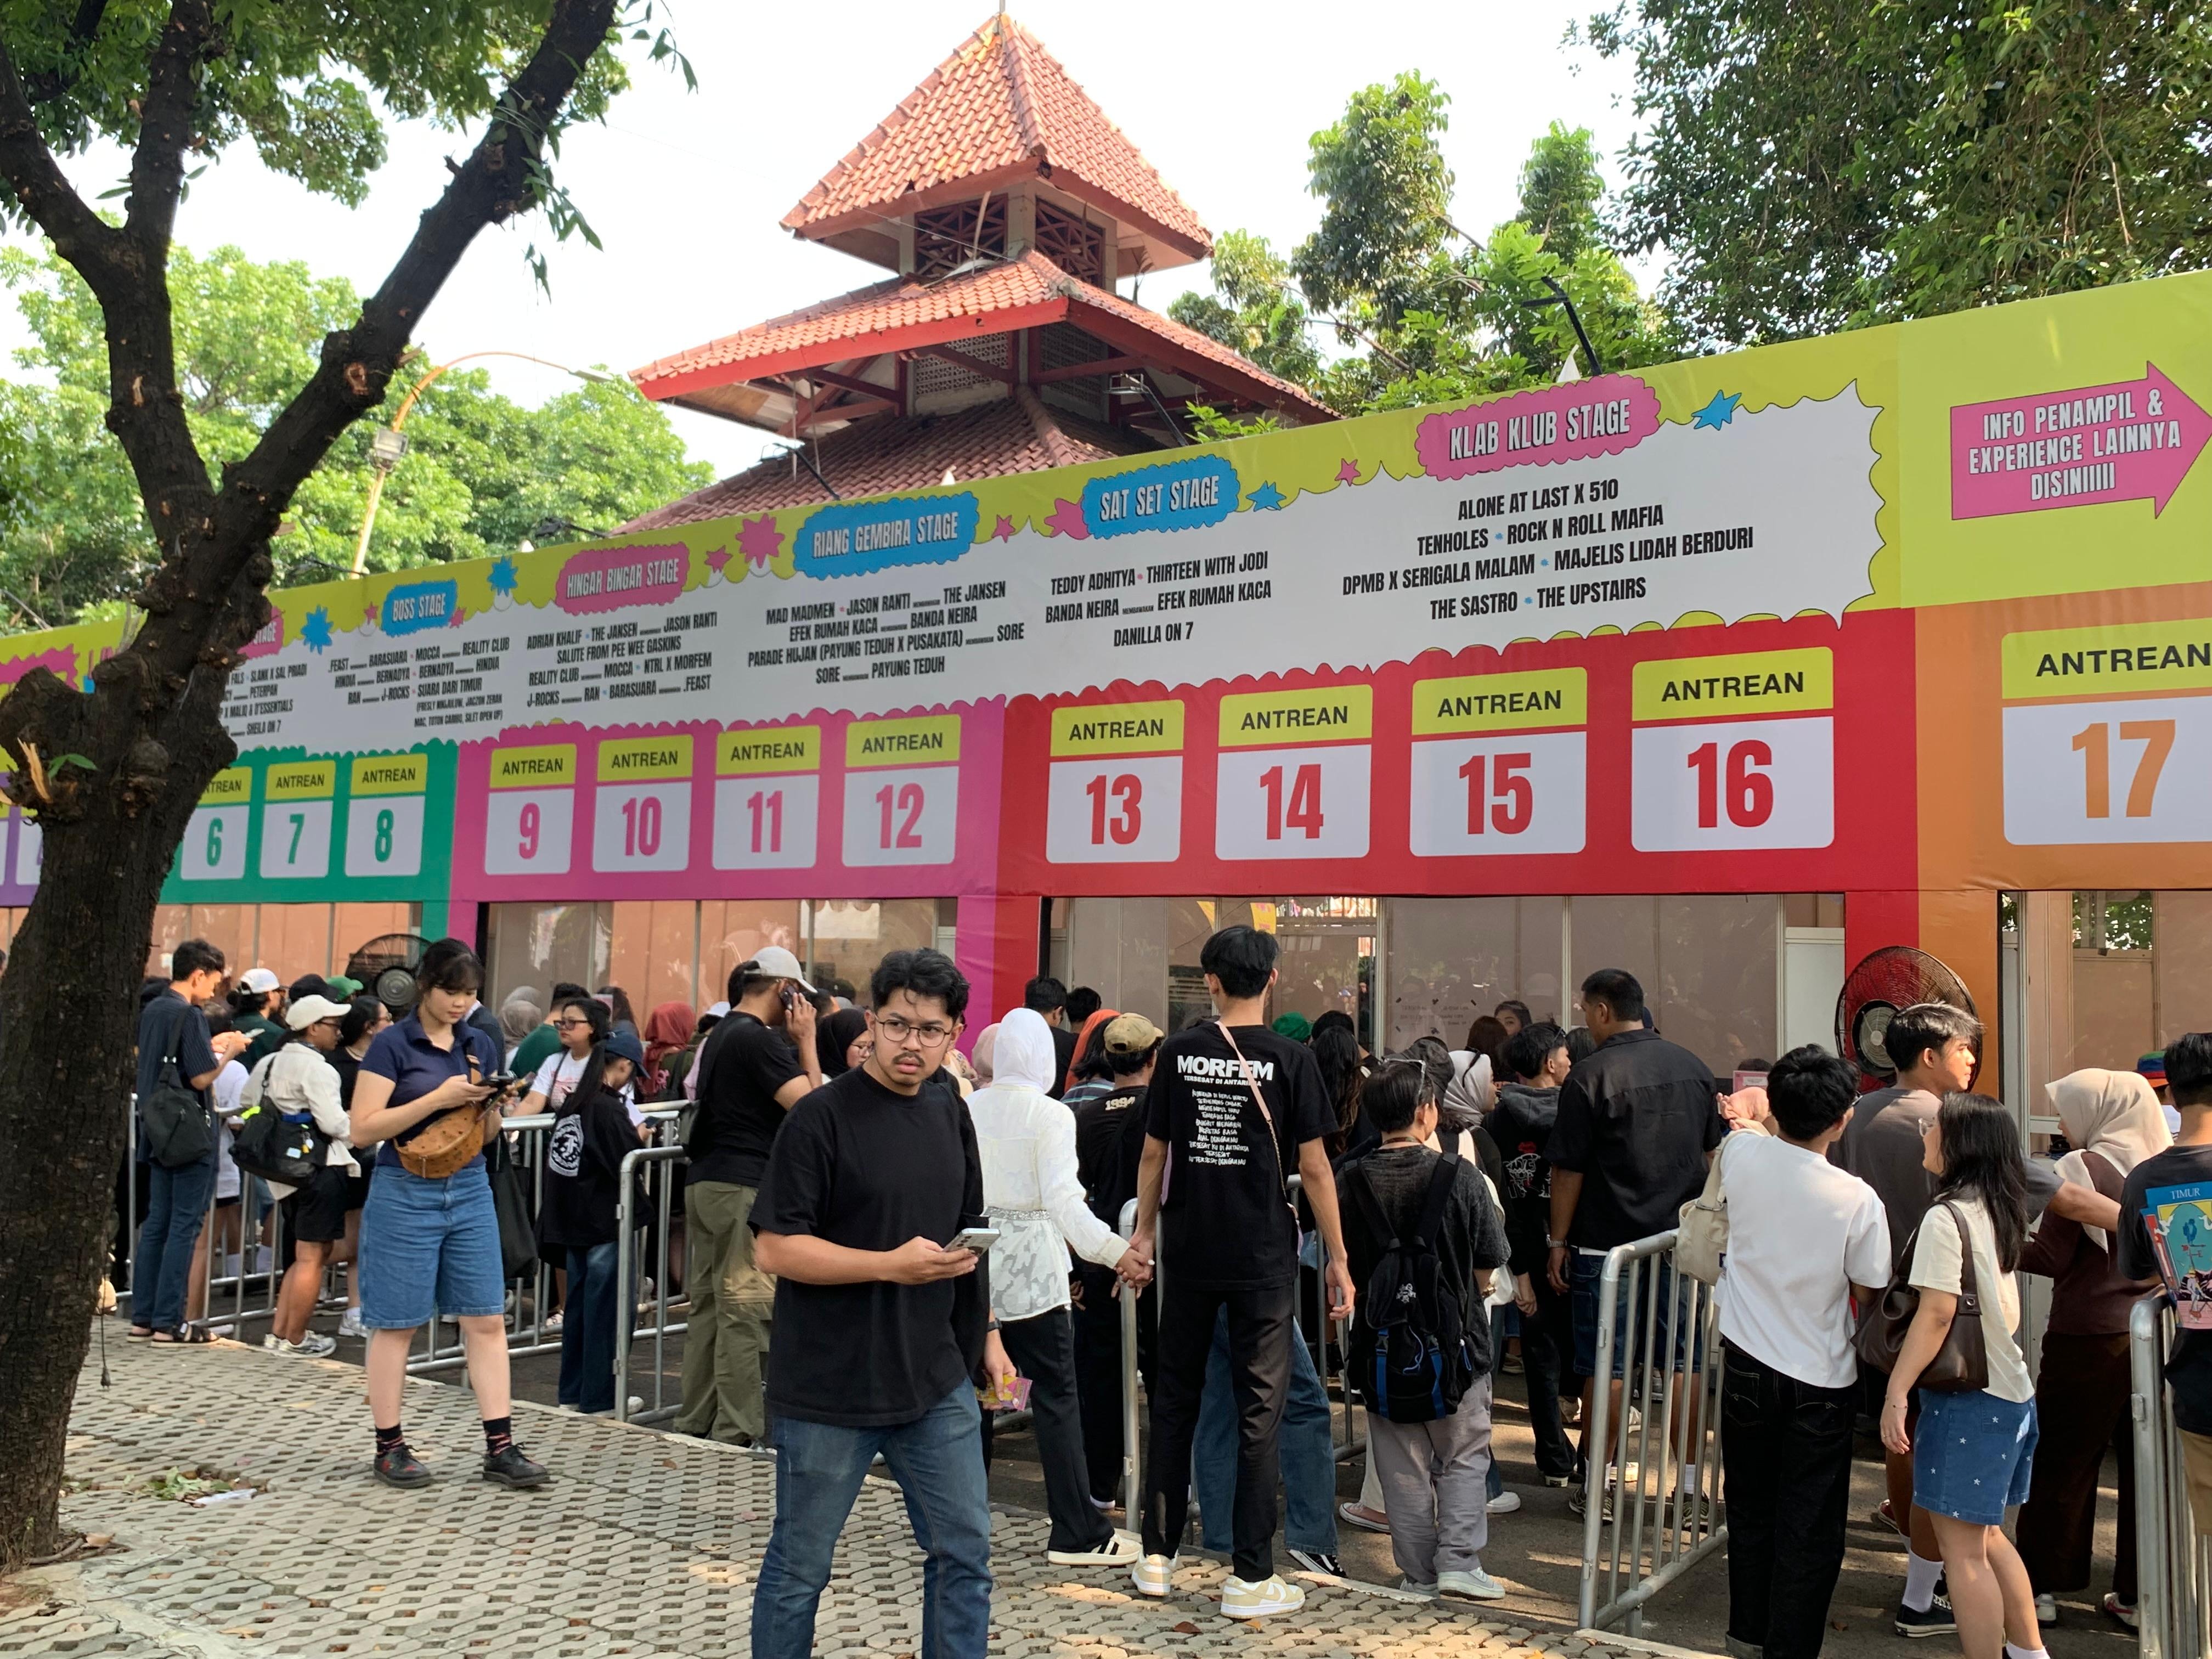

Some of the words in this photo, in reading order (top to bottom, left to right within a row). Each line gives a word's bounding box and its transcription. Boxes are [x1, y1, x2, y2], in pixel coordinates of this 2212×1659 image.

[1449, 421, 1499, 461] KLAB
[1508, 409, 1558, 452] KLUB
[1565, 398, 1630, 441] STAGE
[1983, 410, 2025, 441] INFO
[2035, 391, 2136, 433] PENAMPIL
[2148, 388, 2164, 417] &
[1969, 433, 2083, 475] EXPERIENCE
[2093, 420, 2182, 458] LAINNYA
[1101, 489, 1130, 522] SAT
[1136, 484, 1163, 516] SET
[1170, 475, 1219, 511] STAGE
[1458, 497, 1505, 521] ALONE
[1509, 492, 1528, 514] AT
[1532, 486, 1570, 511] LAST
[1575, 484, 1585, 506] X
[1589, 479, 1619, 503] 510
[812, 529, 849, 558] RIANG
[854, 519, 910, 553] GEMBIRA
[917, 512, 958, 544] STAGE
[1418, 529, 1488, 556] TENHOLES
[1507, 522, 1548, 545] ROCK
[1552, 518, 1562, 539] N
[1567, 512, 1608, 538] ROLL
[1611, 505, 1663, 533] MAFIA
[567, 570, 602, 599] HINGAR
[606, 564, 642, 592] BINGAR
[647, 558, 679, 586] STAGE
[1051, 575, 1085, 595] TEDDY
[1088, 568, 1135, 591] ADHITYA
[1147, 560, 1200, 584] THIRTEEN
[1205, 555, 1235, 576] WITH
[1239, 551, 1268, 572] JODI
[1342, 572, 1384, 596] DPMB
[1388, 569, 1398, 591] X
[1402, 560, 1470, 589] SERIGALA
[1475, 555, 1535, 581] MALAM
[1554, 545, 1624, 572] MAJELIS
[1629, 537, 1678, 562] LIDAH
[1683, 526, 1753, 555] BERDURI
[393, 598, 415, 622] BOSS
[419, 592, 445, 618] STAGE
[766, 607, 788, 625] MAD
[791, 602, 835, 622] MADMEN
[847, 597, 879, 616] JASON
[882, 593, 911, 612] RANTI
[944, 586, 961, 605] THE
[965, 581, 1006, 602] JANSEN
[1046, 603, 1082, 623] BANDA
[1087, 599, 1119, 619] NEIRA
[1158, 590, 1185, 611] EFEK
[1189, 584, 1234, 607] RUMAH
[1238, 580, 1271, 601] KACA
[1431, 598, 1456, 620] THE
[1460, 591, 1518, 618] SASTRO
[1537, 586, 1565, 610] THE
[1570, 577, 1646, 606] UPSTAIRS
[527, 633, 554, 650] ADRIAN
[556, 630, 582, 646] KHALIF
[591, 627, 605, 641] THE
[607, 622, 638, 640] JANSEN
[664, 616, 691, 633] JASON
[693, 612, 717, 629] RANTI
[790, 626, 811, 642] EFEK
[814, 621, 849, 640] RUMAH
[853, 617, 877, 635] KACA
[911, 610, 944, 629] BANDA
[948, 606, 977, 624] NEIRA
[1114, 625, 1161, 647] DANILLA
[1165, 624, 1181, 642] ON
[1186, 622, 1193, 640] 7
[369, 650, 407, 667] BARASUARA
[416, 646, 440, 661] MOCCA
[462, 640, 489, 656] REALITY
[492, 637, 510, 652] CLUB
[557, 647, 584, 664] SALUTE
[586, 645, 608, 661] FROM
[612, 643, 625, 658] PEE
[628, 640, 645, 656] WEE
[647, 635, 681, 653] GASKINS
[748, 649, 783, 667] PARADE
[786, 645, 817, 664] HUJAN
[820, 641, 861, 661] (PAYUNG
[865, 637, 894, 656] TEDUH
[898, 636, 904, 652] X
[907, 629, 963, 651] PUSAKATA)
[997, 623, 1024, 642] SORE
[2035, 642, 2211, 677] ANTREAN
[376, 668, 410, 684] BERNADYA
[419, 662, 454, 679] BERNADYA
[476, 657, 499, 672] HINDIA
[418, 684, 439, 697] SUARA
[442, 680, 458, 695] DARI
[460, 678, 482, 692] TIMUR
[529, 669, 558, 686] REALITY
[560, 668, 579, 683] CLUB
[604, 661, 633, 678] MOCCA
[645, 658, 663, 674] NTRL
[667, 657, 672, 671] X
[675, 652, 712, 670] MORFEM
[816, 667, 840, 684] SORE
[872, 659, 910, 679] PAYUNG
[913, 656, 945, 675] TEDUH
[1662, 671, 1804, 703] ANTREAN
[527, 690, 560, 707] J-ROCKS
[584, 687, 600, 702] RAN
[610, 680, 656, 699] BARASUARA
[684, 675, 711, 692] .FEAST
[1437, 690, 1562, 719] ANTREAN
[1069, 719, 1164, 742] ANTREAN
[1240, 705, 1348, 731] ANTREAN
[611, 751, 678, 769] ANTREAN
[731, 741, 805, 763] ANTREAN
[862, 732, 943, 754] ANTREAN
[276, 775, 325, 788] ANTREAN
[363, 768, 416, 783] ANTREAN
[503, 758, 563, 776] ANTREAN
[1688, 740, 1774, 829] 16
[2072, 718, 2176, 819] 17
[1086, 774, 1142, 845] 13
[1259, 764, 1324, 841] 14
[1459, 753, 1533, 836] 15
[375, 809, 394, 862] 8
[519, 802, 541, 860] 9
[622, 796, 662, 856] 10
[747, 790, 783, 854] 11
[876, 783, 924, 849] 12
[207, 817, 223, 867] 6
[288, 813, 304, 864] 7
[1184, 1075, 1214, 1084] TERSESAT
[2170, 1188, 2200, 1200] TIMUR
